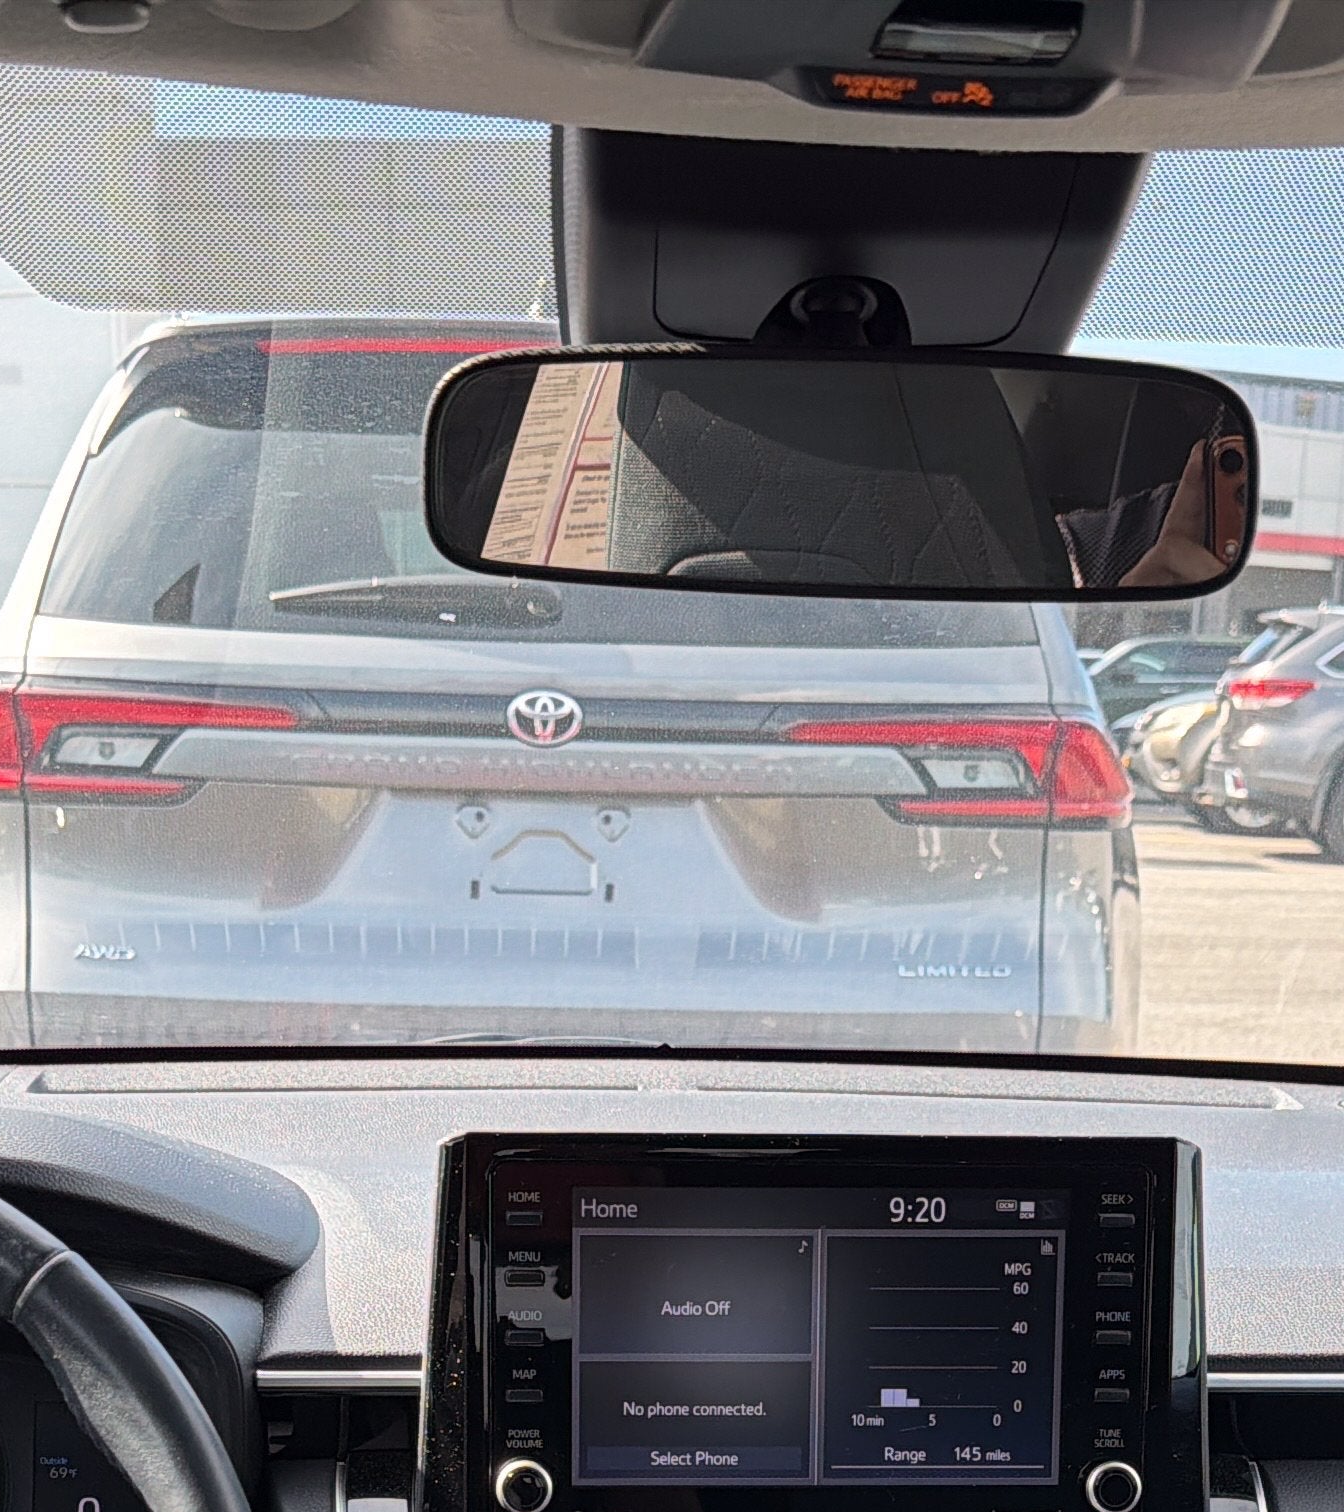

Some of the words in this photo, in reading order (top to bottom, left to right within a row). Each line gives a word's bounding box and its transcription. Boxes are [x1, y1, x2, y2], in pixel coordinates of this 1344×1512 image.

[931, 91, 962, 103] OFF
[74, 943, 136, 960] AWD
[897, 963, 1012, 978] LIMITED
[508, 1192, 541, 1203] HOME
[580, 1197, 639, 1219] Home
[889, 1197, 947, 1223] 9:20
[508, 1251, 541, 1263] MENU
[1004, 1262, 1032, 1276] MPG
[1012, 1282, 1029, 1295] 60
[660, 1300, 703, 1316] Audio
[705, 1300, 731, 1316] Off
[507, 1310, 543, 1322] AUDIO
[1095, 1311, 1131, 1322] PHONE
[1011, 1321, 1028, 1334] 40
[1010, 1361, 1027, 1374] 20
[512, 1369, 537, 1380] MAP
[1099, 1369, 1126, 1380] APPS
[622, 1401, 645, 1417] No
[647, 1401, 690, 1419] phone
[692, 1400, 767, 1417] connected.
[1013, 1399, 1022, 1413] 0
[851, 1414, 865, 1427] 10
[866, 1414, 885, 1427] min
[928, 1413, 936, 1427] 5
[992, 1413, 1002, 1427] 0
[507, 1429, 540, 1439] POWER
[1099, 1429, 1121, 1439] TUNE
[506, 1439, 544, 1449] VOLUME
[1094, 1438, 1125, 1449] SCROLL
[39, 1456, 68, 1465] Outside
[650, 1450, 692, 1467] Select
[695, 1450, 739, 1467] Phone
[884, 1446, 927, 1464] Range
[953, 1446, 982, 1461] 145
[986, 1449, 1011, 1462] miles
